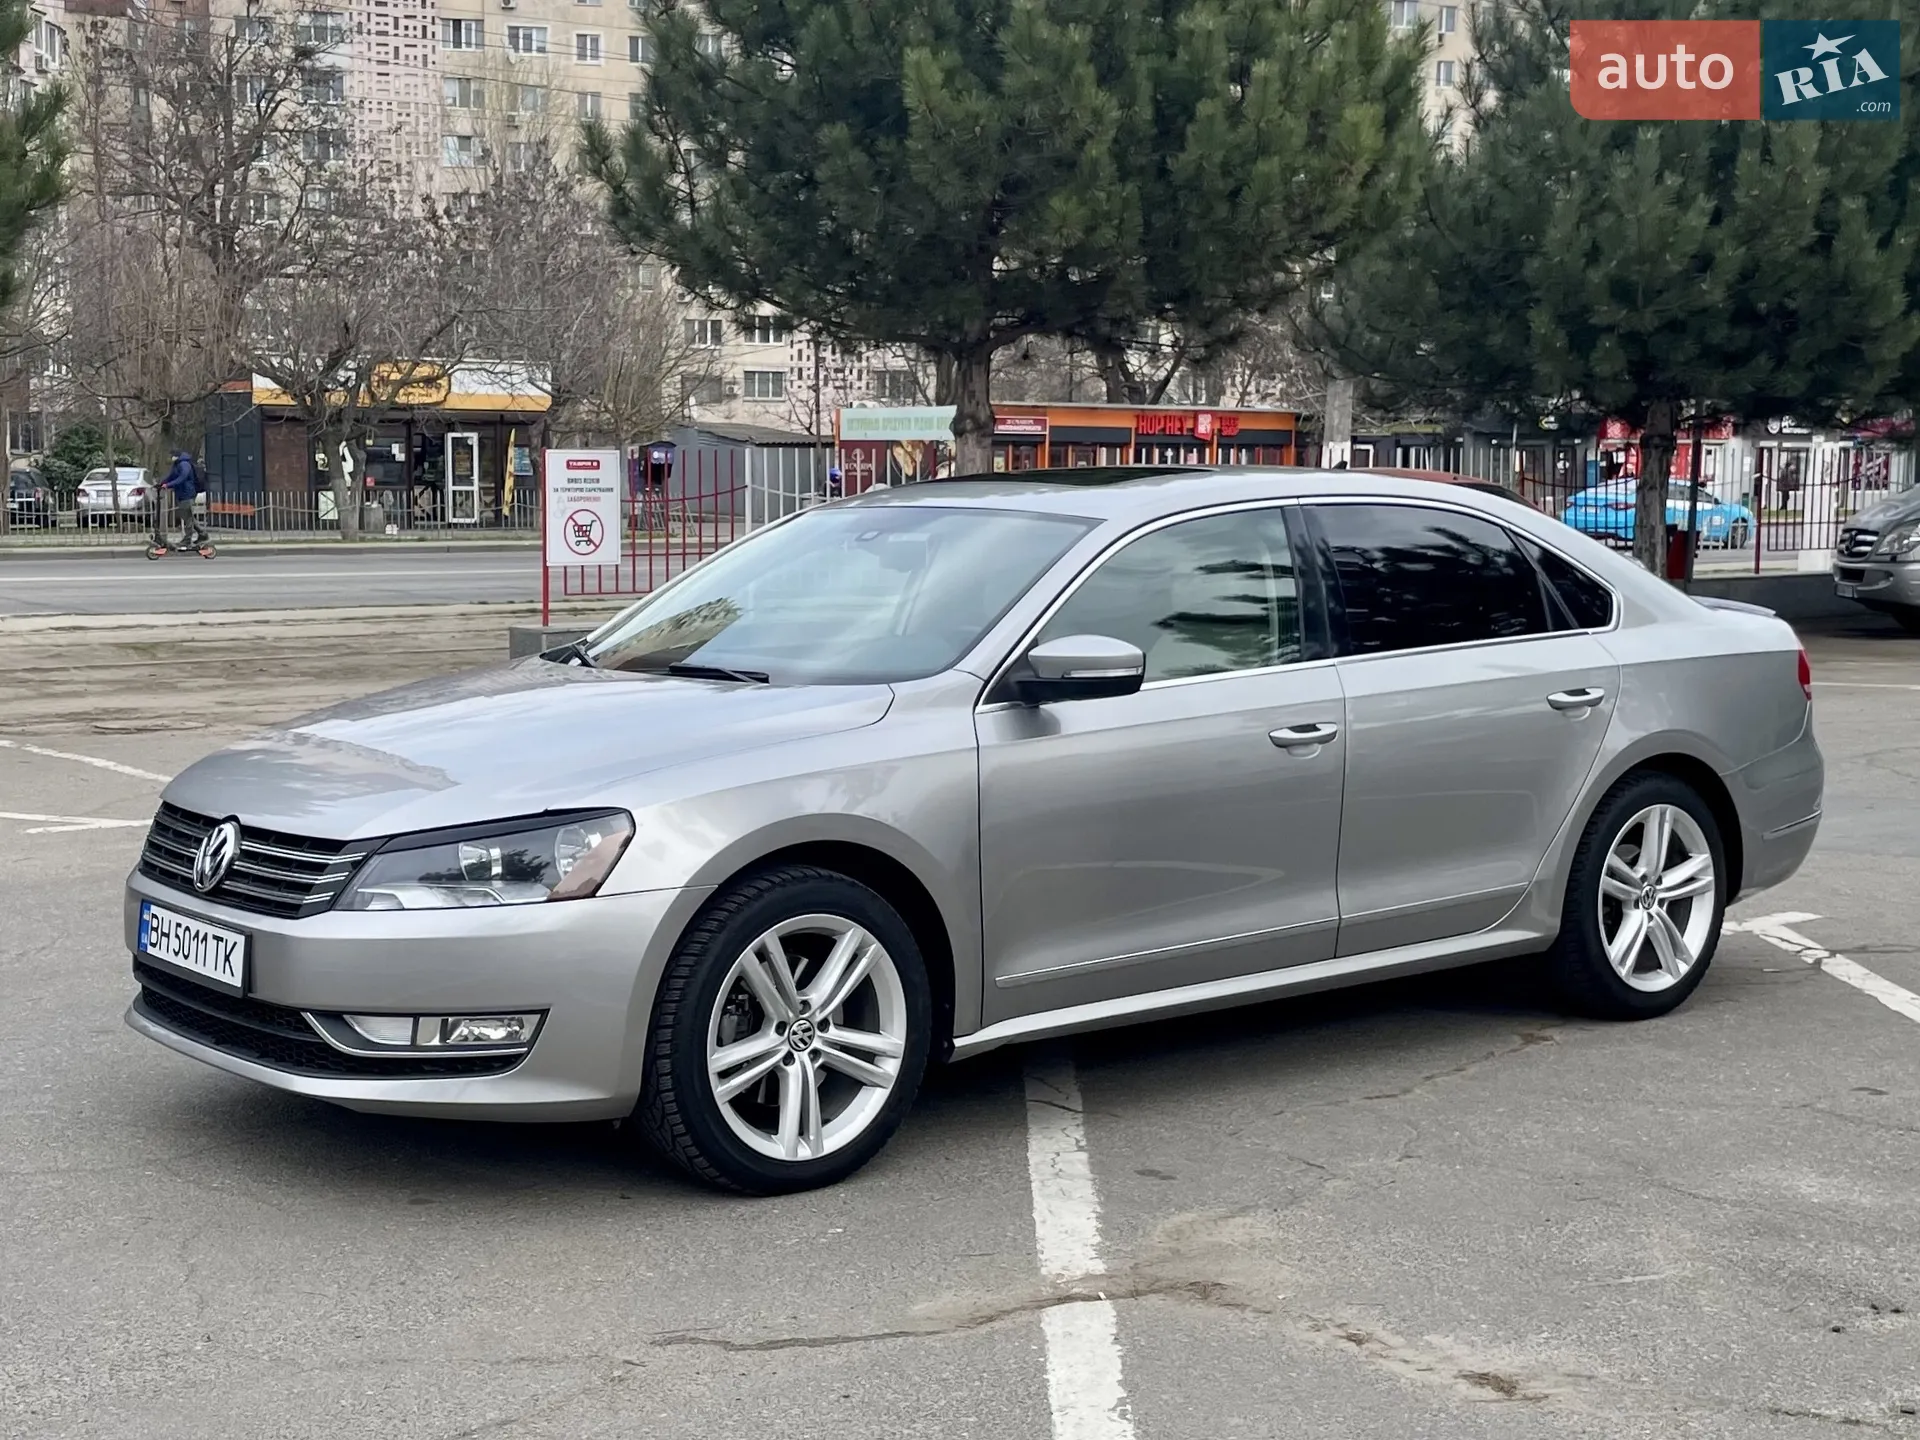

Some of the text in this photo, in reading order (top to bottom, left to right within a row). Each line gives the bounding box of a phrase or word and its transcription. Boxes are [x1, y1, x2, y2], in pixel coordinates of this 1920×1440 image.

[1138, 415, 1188, 435] HOP HEY
[173, 922, 208, 967] 5011
